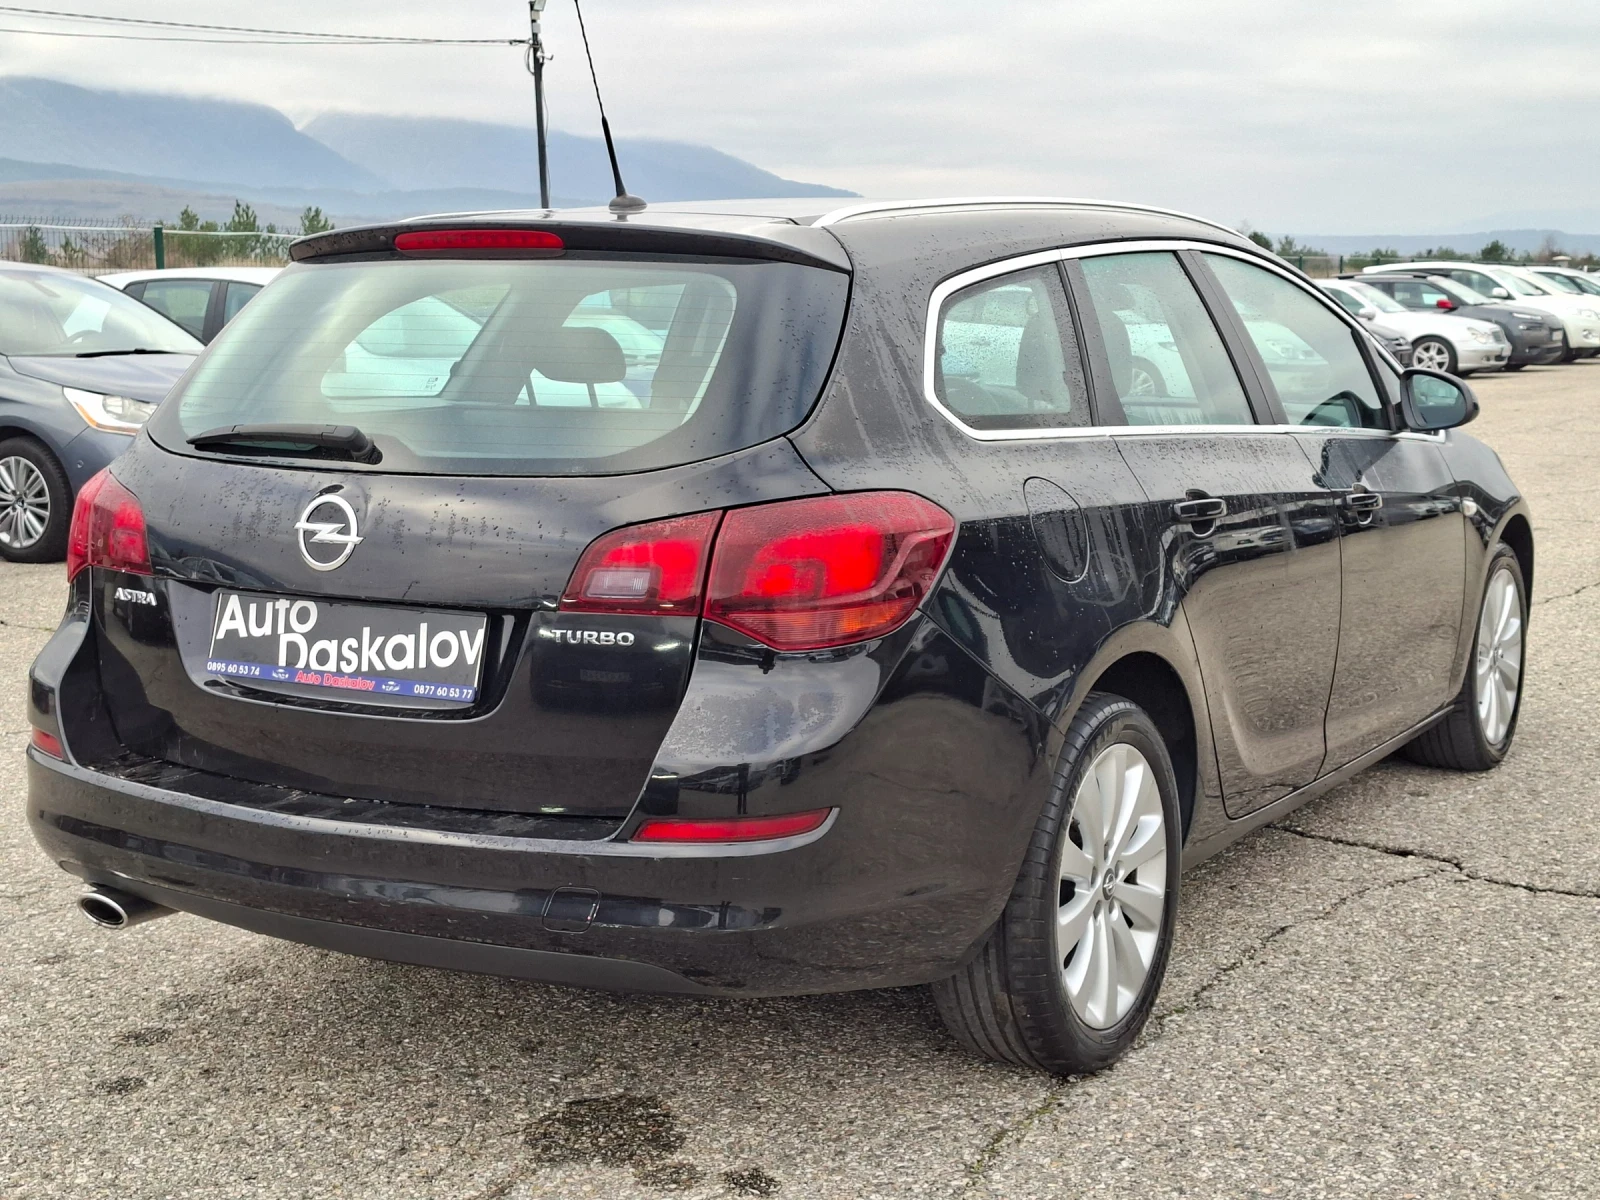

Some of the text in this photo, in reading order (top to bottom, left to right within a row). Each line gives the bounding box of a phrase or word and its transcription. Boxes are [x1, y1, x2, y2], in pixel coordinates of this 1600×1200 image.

[114, 587, 157, 606] ASTRA
[216, 595, 318, 639] Auto
[551, 629, 635, 646] TURBO
[278, 623, 485, 673] Daskalov
[206, 661, 260, 676] 0895 60 53 74
[295, 670, 375, 691] Auto Daskalov
[414, 684, 473, 699] 0877 60 53 77
